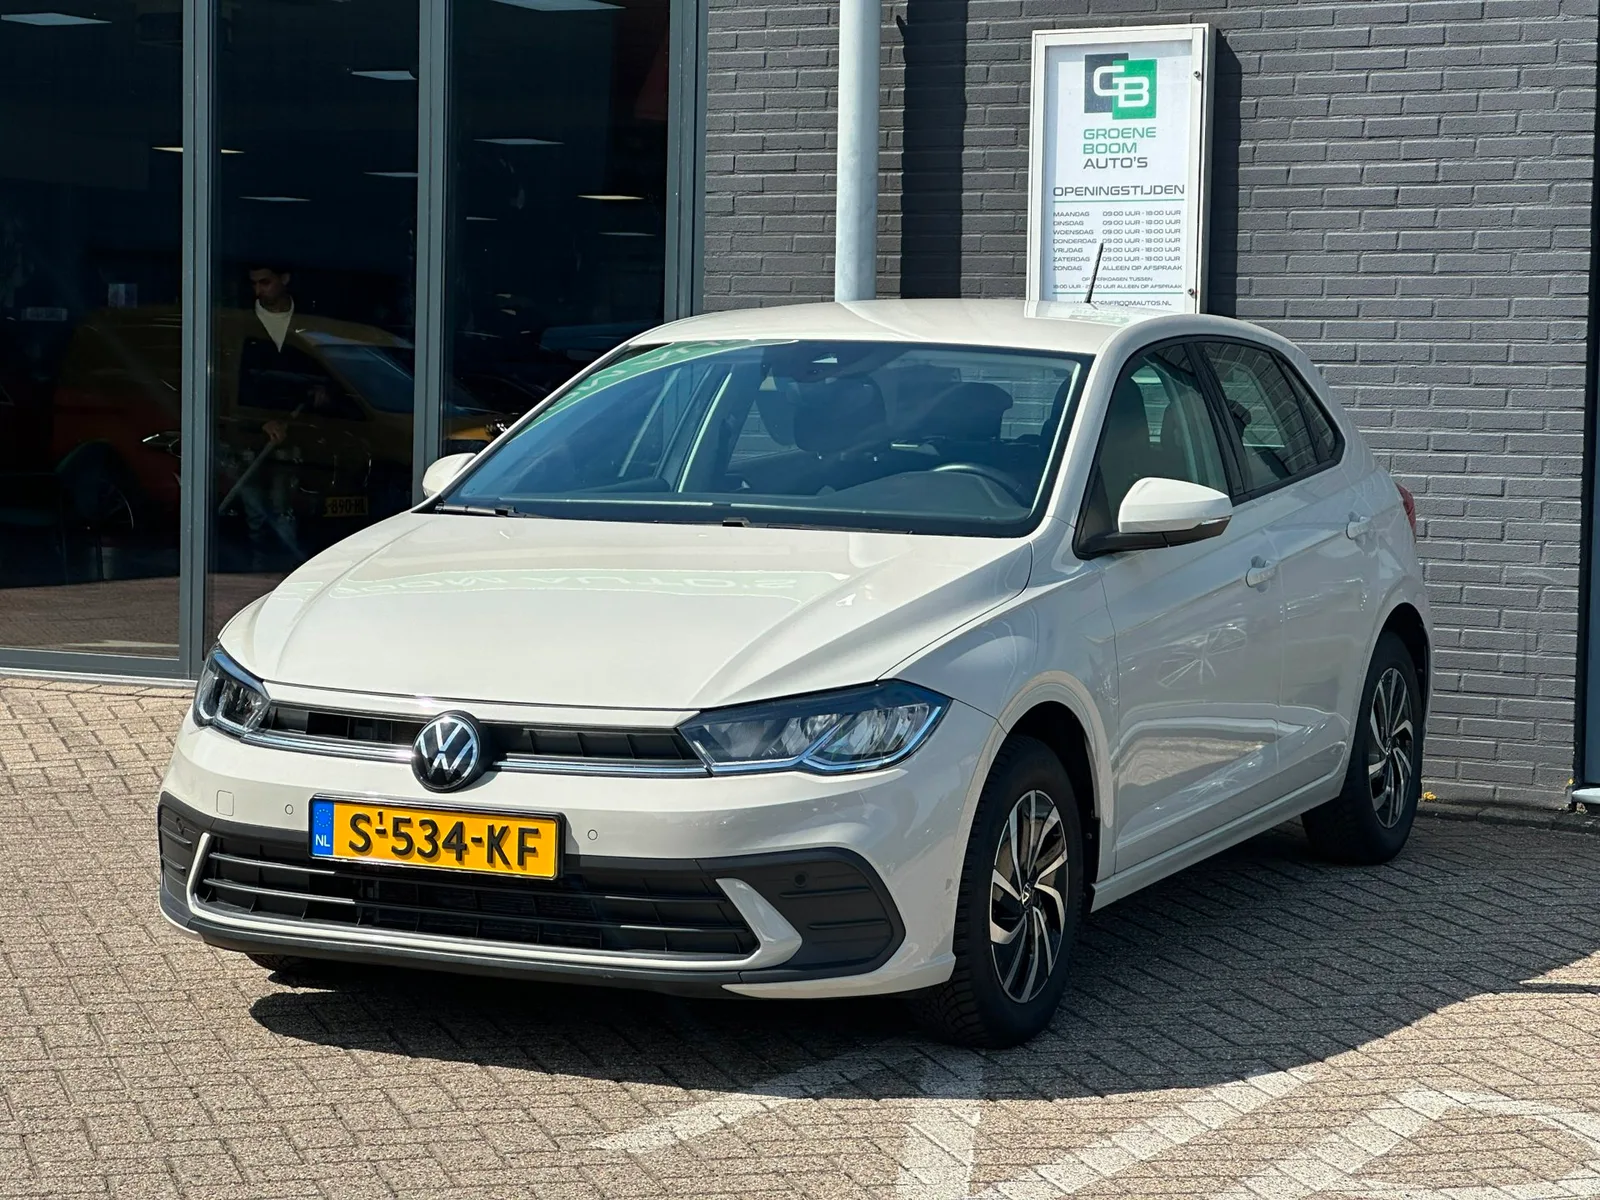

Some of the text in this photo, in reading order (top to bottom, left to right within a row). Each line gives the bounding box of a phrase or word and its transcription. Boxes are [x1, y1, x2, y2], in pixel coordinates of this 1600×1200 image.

[1083, 127, 1157, 140] GROENE
[1083, 142, 1137, 155] BOOM
[1083, 157, 1149, 170] AUTO'S
[1052, 184, 1185, 197] OPENINGSTIJDEN
[315, 834, 331, 848] NL
